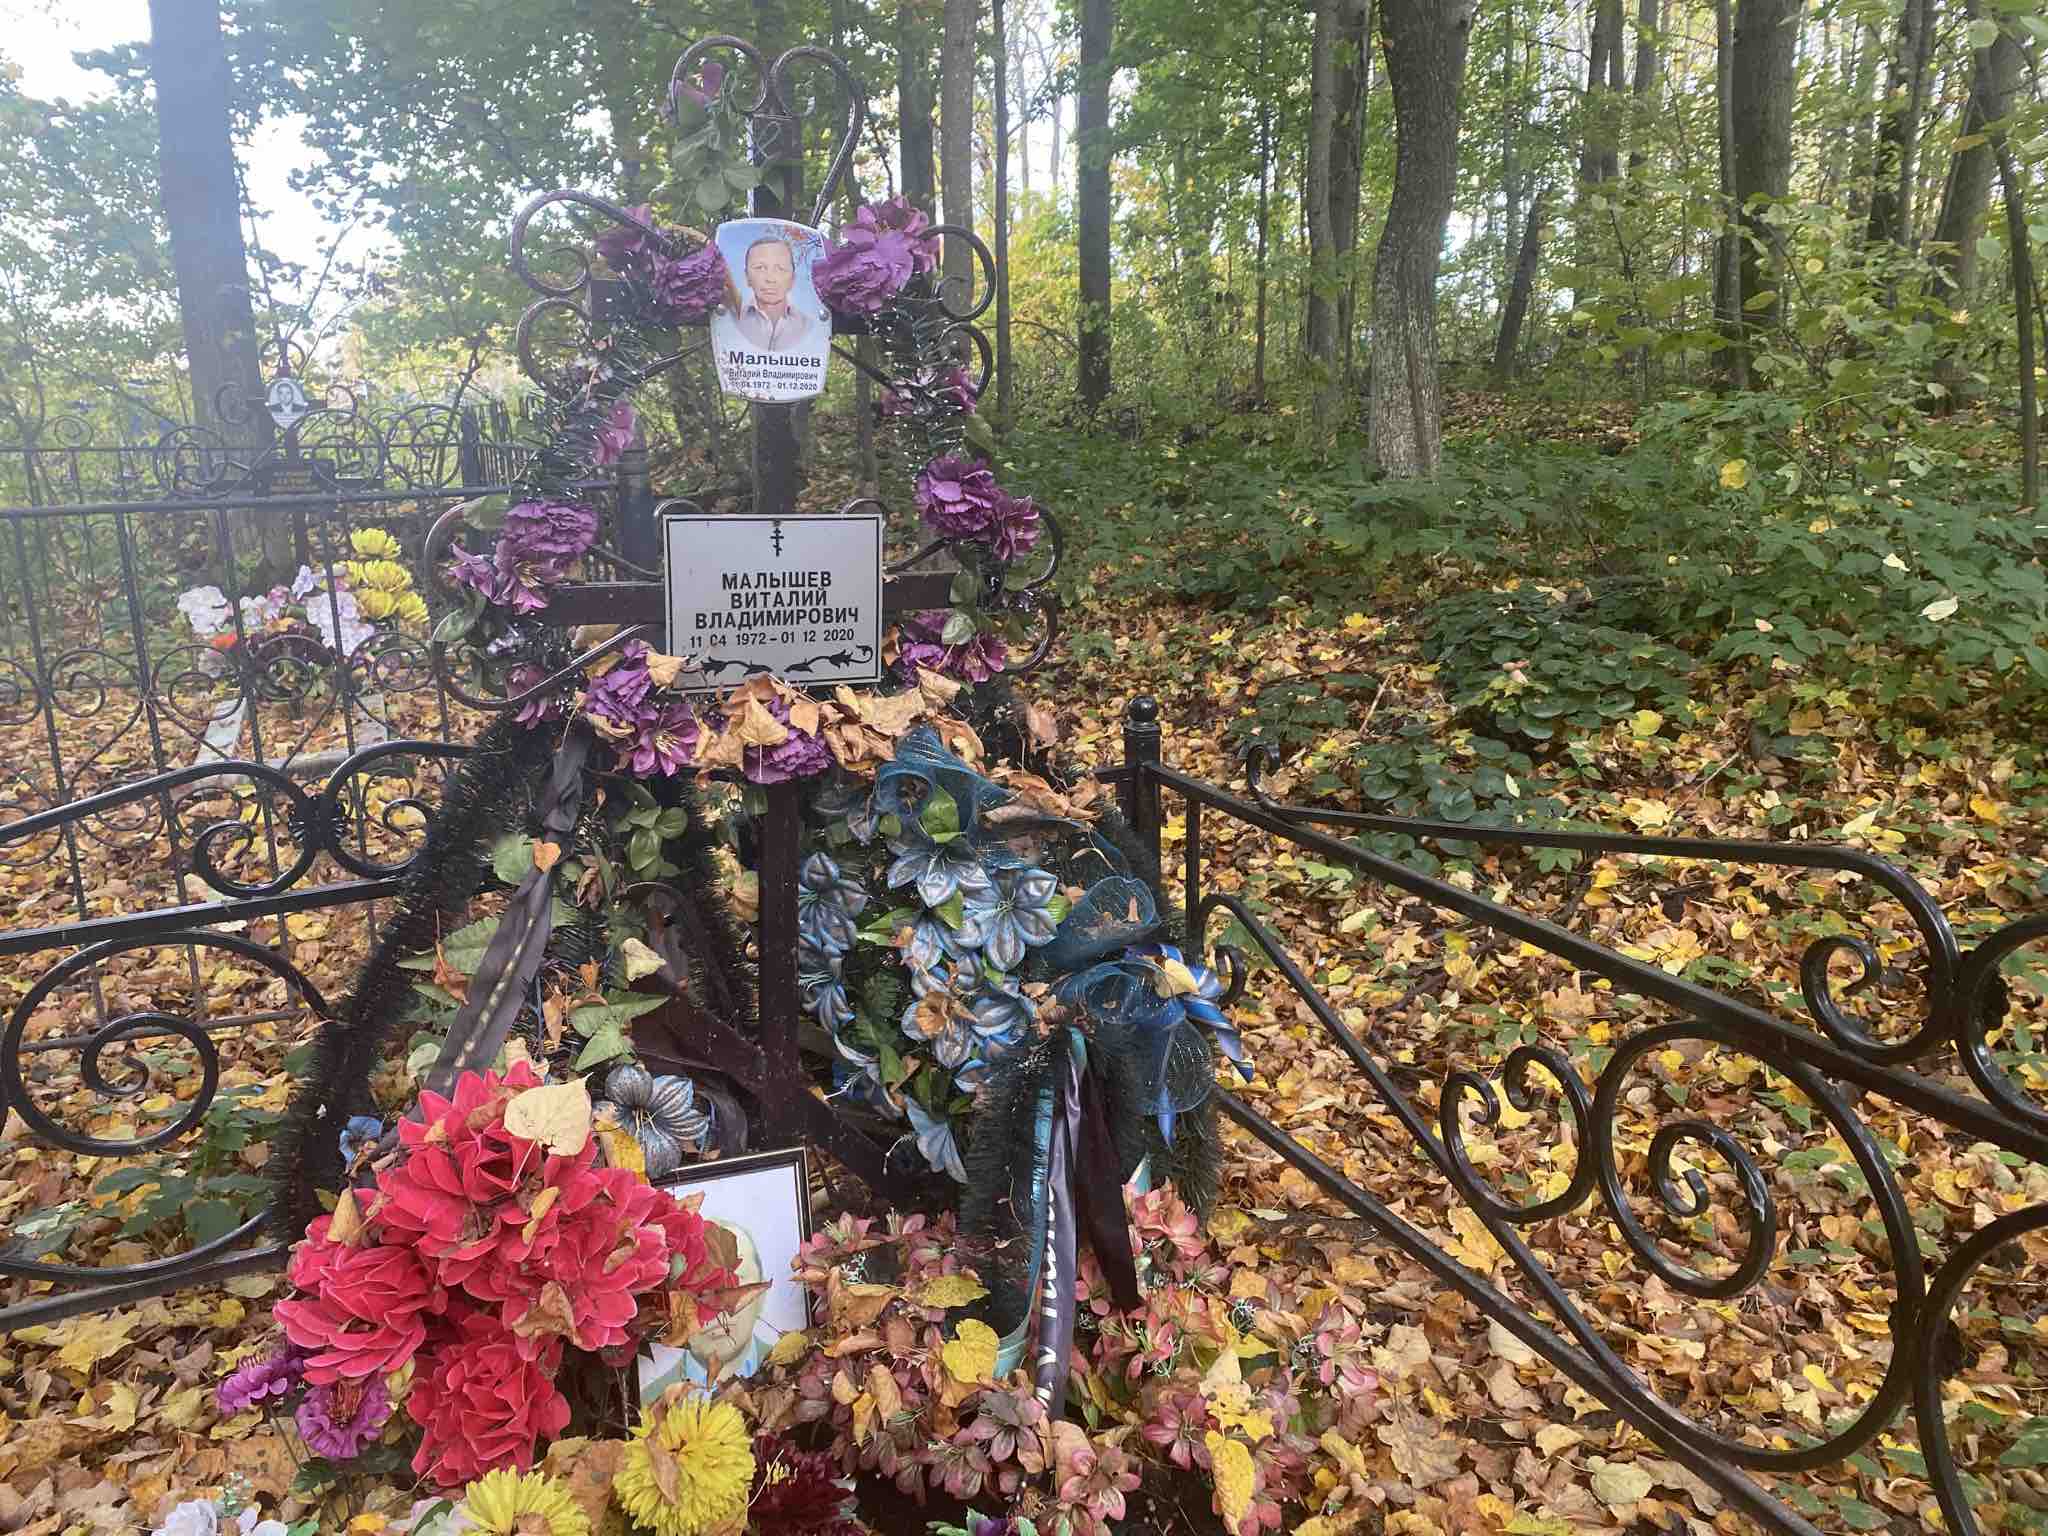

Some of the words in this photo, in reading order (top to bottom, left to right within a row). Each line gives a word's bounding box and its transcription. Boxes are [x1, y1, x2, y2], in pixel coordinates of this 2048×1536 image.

[729, 351, 821, 367] Малышев
[722, 571, 832, 590] МАЛЫШЕВ
[731, 588, 827, 609] ВИТАЛИЙ
[695, 607, 859, 631] ВЛАДИМИРОВИЧ
[690, 636, 702, 648] 11
[803, 630, 816, 642] 12
[824, 628, 854, 641] 2020
